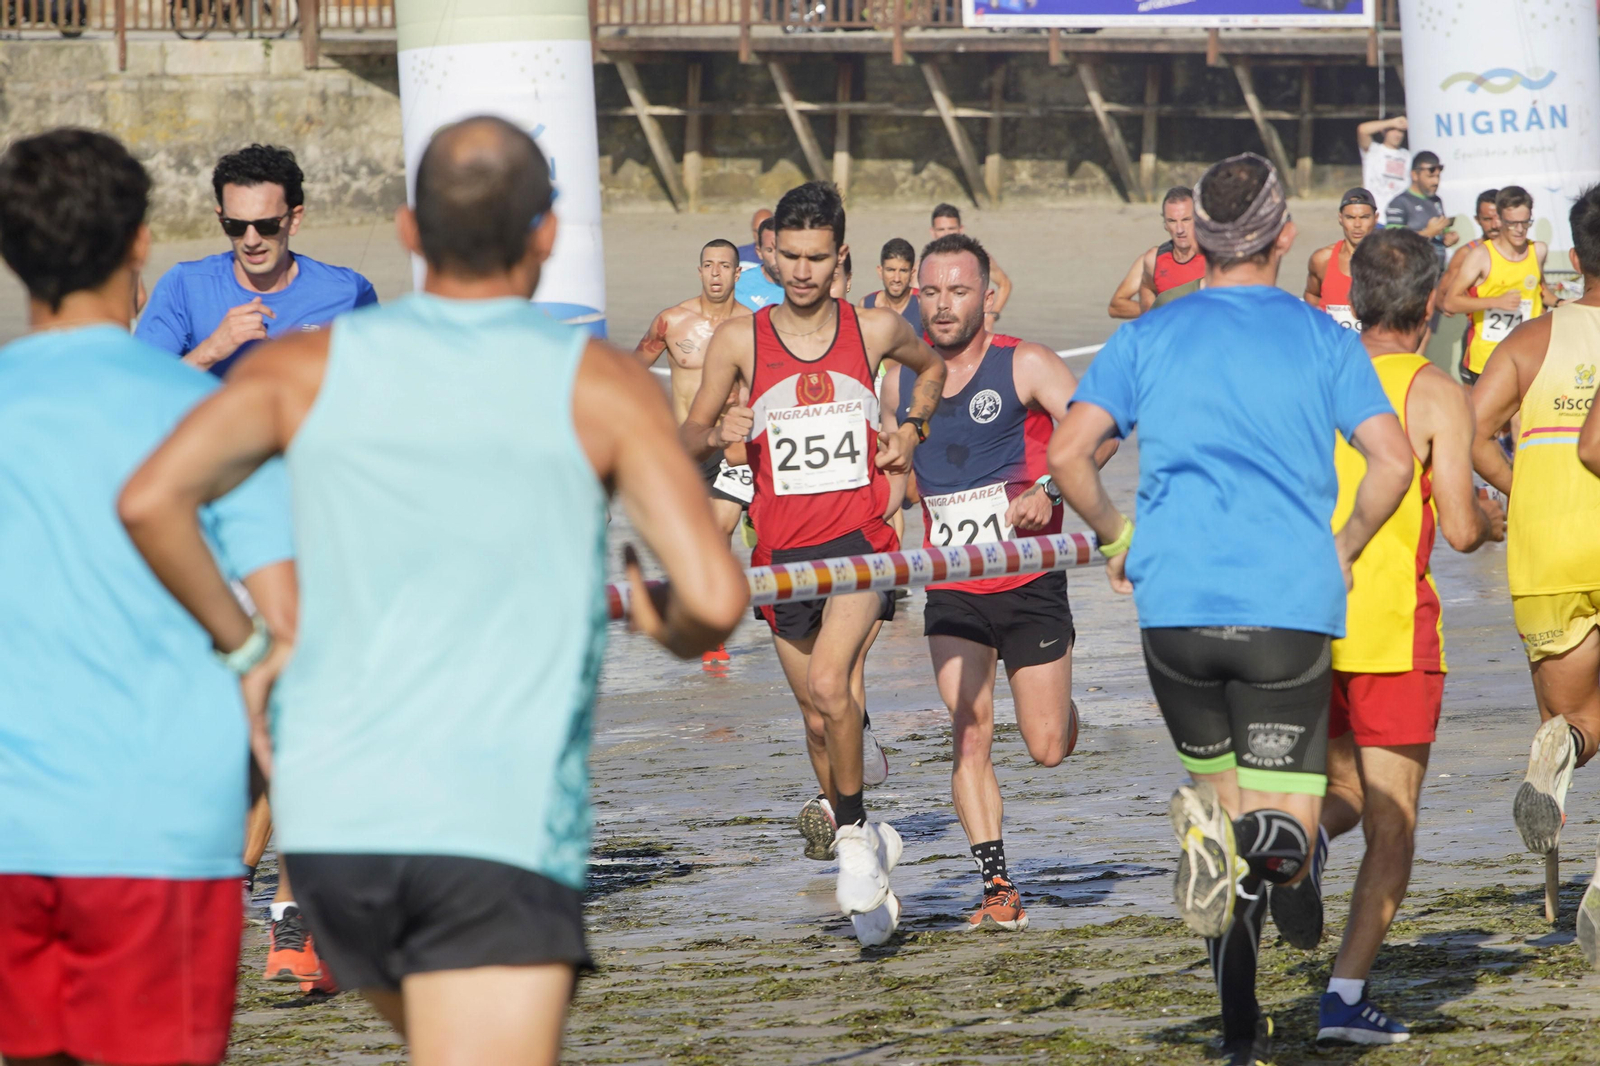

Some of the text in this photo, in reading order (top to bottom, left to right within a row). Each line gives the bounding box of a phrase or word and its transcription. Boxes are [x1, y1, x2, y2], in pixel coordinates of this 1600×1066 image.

[1435, 100, 1568, 137] NIGRÁN
[825, 401, 863, 416] AREA
[775, 430, 861, 472] 254
[968, 485, 1004, 502] AREA
[938, 513, 1003, 547] 221
